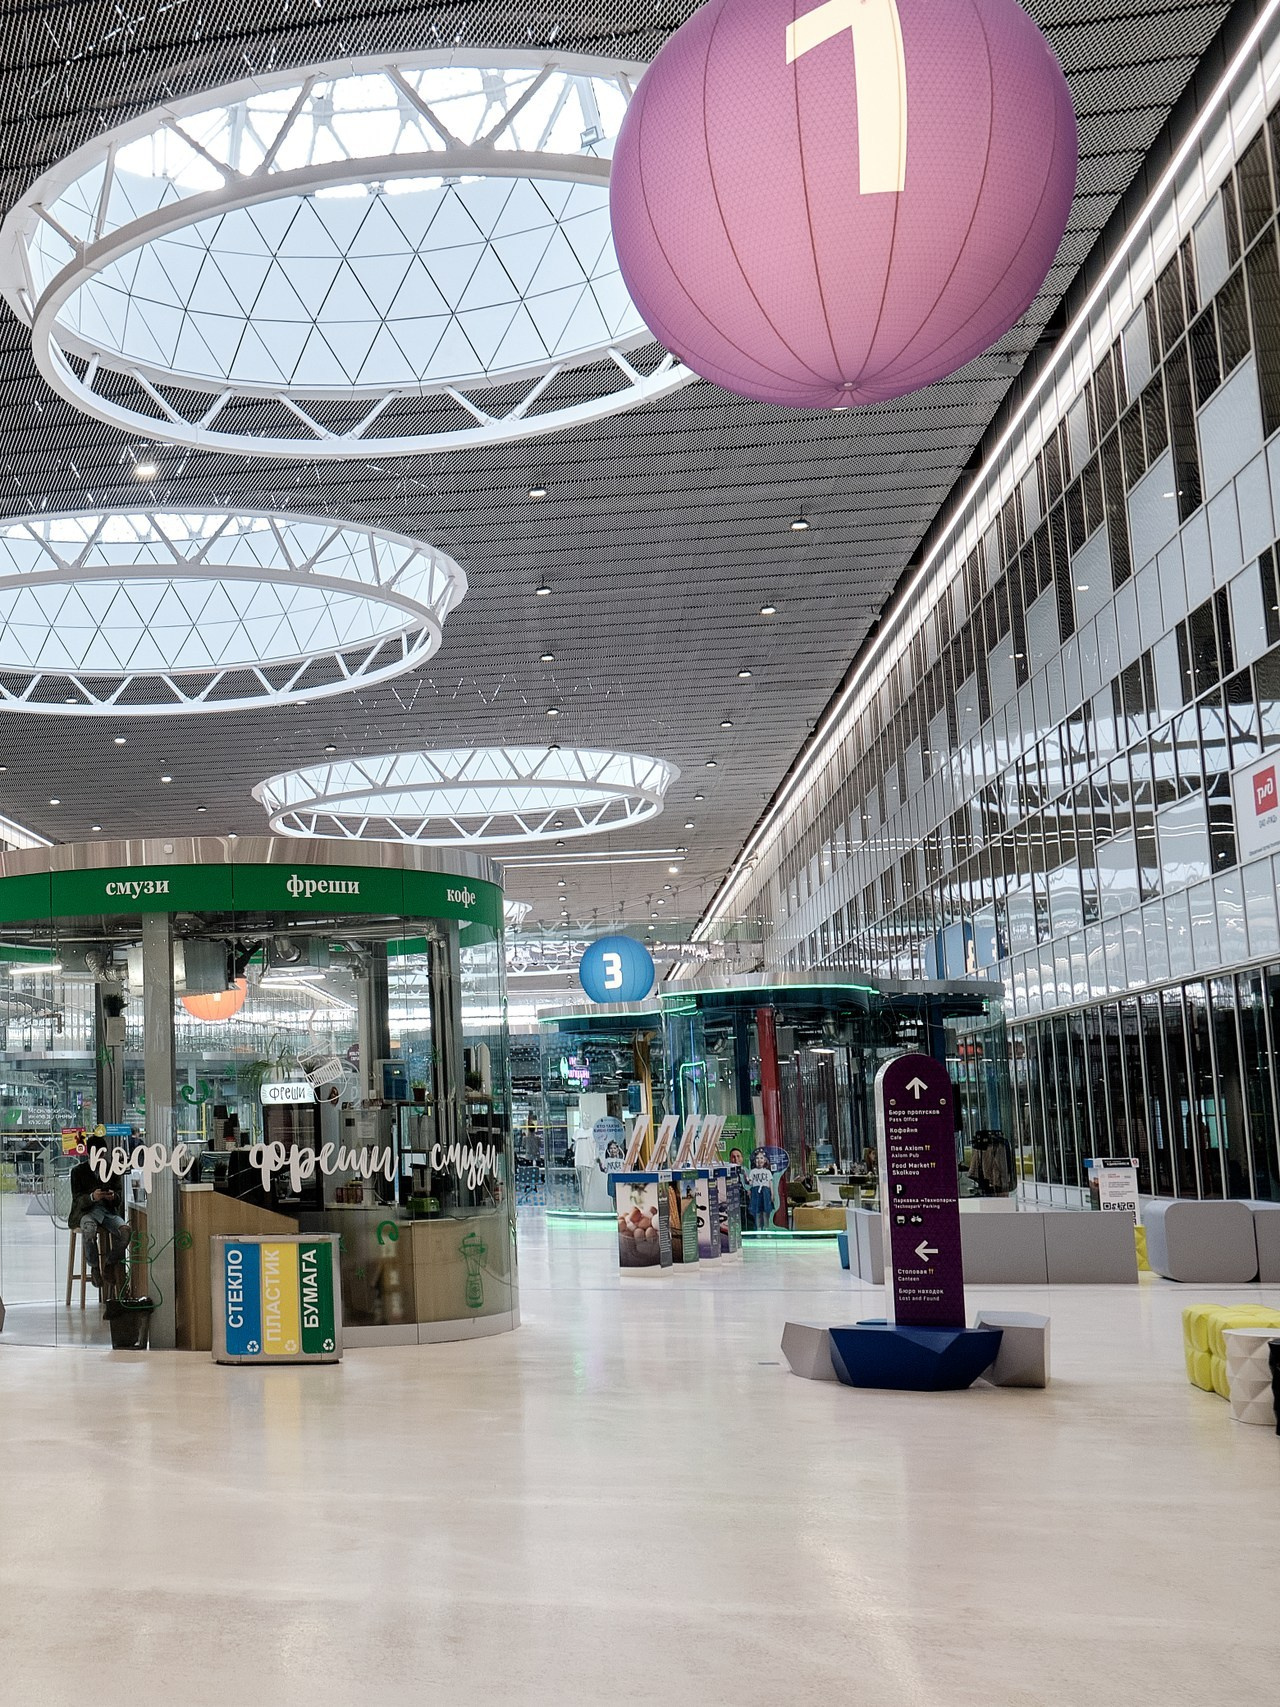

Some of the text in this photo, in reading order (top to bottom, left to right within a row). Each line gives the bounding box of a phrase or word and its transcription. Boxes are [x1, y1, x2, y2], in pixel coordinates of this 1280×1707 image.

[785, 0, 908, 195] 1
[105, 879, 170, 900] смузи
[286, 874, 361, 898] фреши
[446, 886, 477, 909] кофе
[602, 952, 623, 990] 3
[89, 1143, 196, 1194] кофе
[249, 1140, 400, 1194] фреши
[431, 1141, 499, 1191] смузи
[227, 1249, 244, 1329] СТЕКЛО
[264, 1249, 281, 1342] ПЛАСТИК
[301, 1249, 319, 1328] БУМАГА
